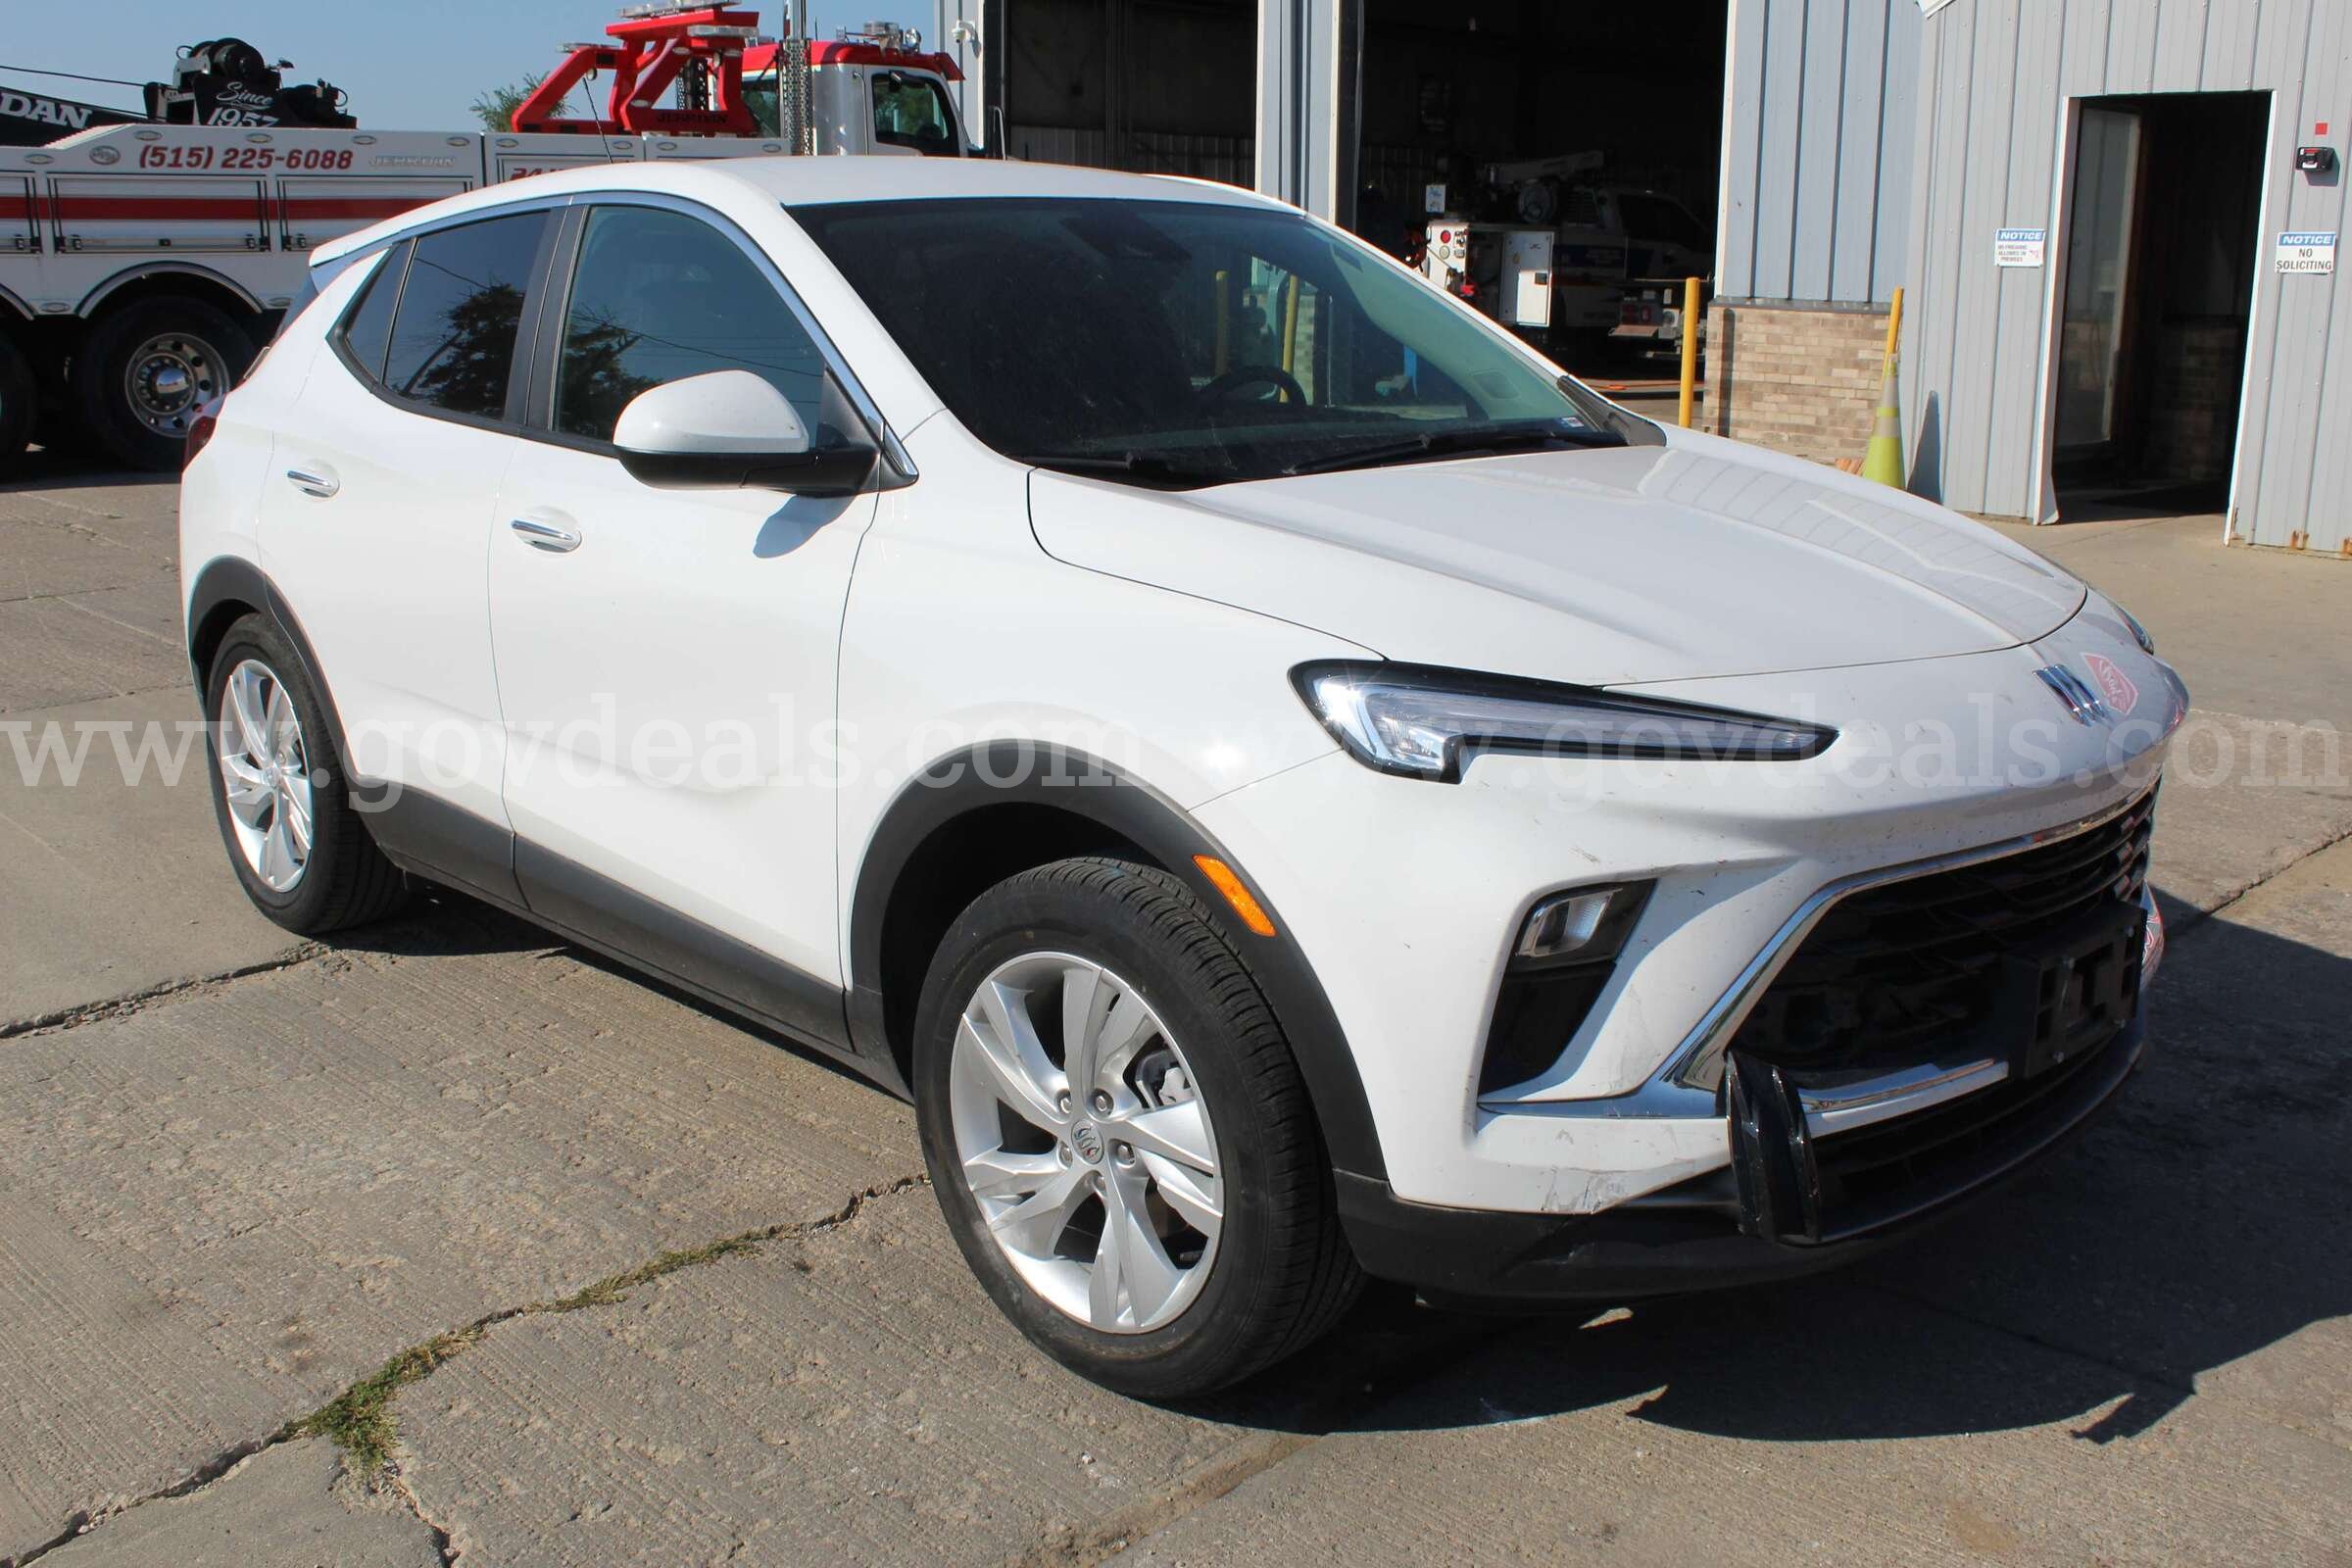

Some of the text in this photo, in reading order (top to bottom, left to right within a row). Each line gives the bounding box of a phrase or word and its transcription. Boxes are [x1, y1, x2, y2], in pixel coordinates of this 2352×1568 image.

[216, 81, 273, 105] Since
[139, 145, 214, 169] (515)
[220, 147, 353, 171] 225-6088
[2000, 231, 2042, 240] NOTICE
[2282, 234, 2332, 244] NOTICE
[2298, 248, 2313, 258] NO
[2277, 260, 2332, 270] SOLICITING
